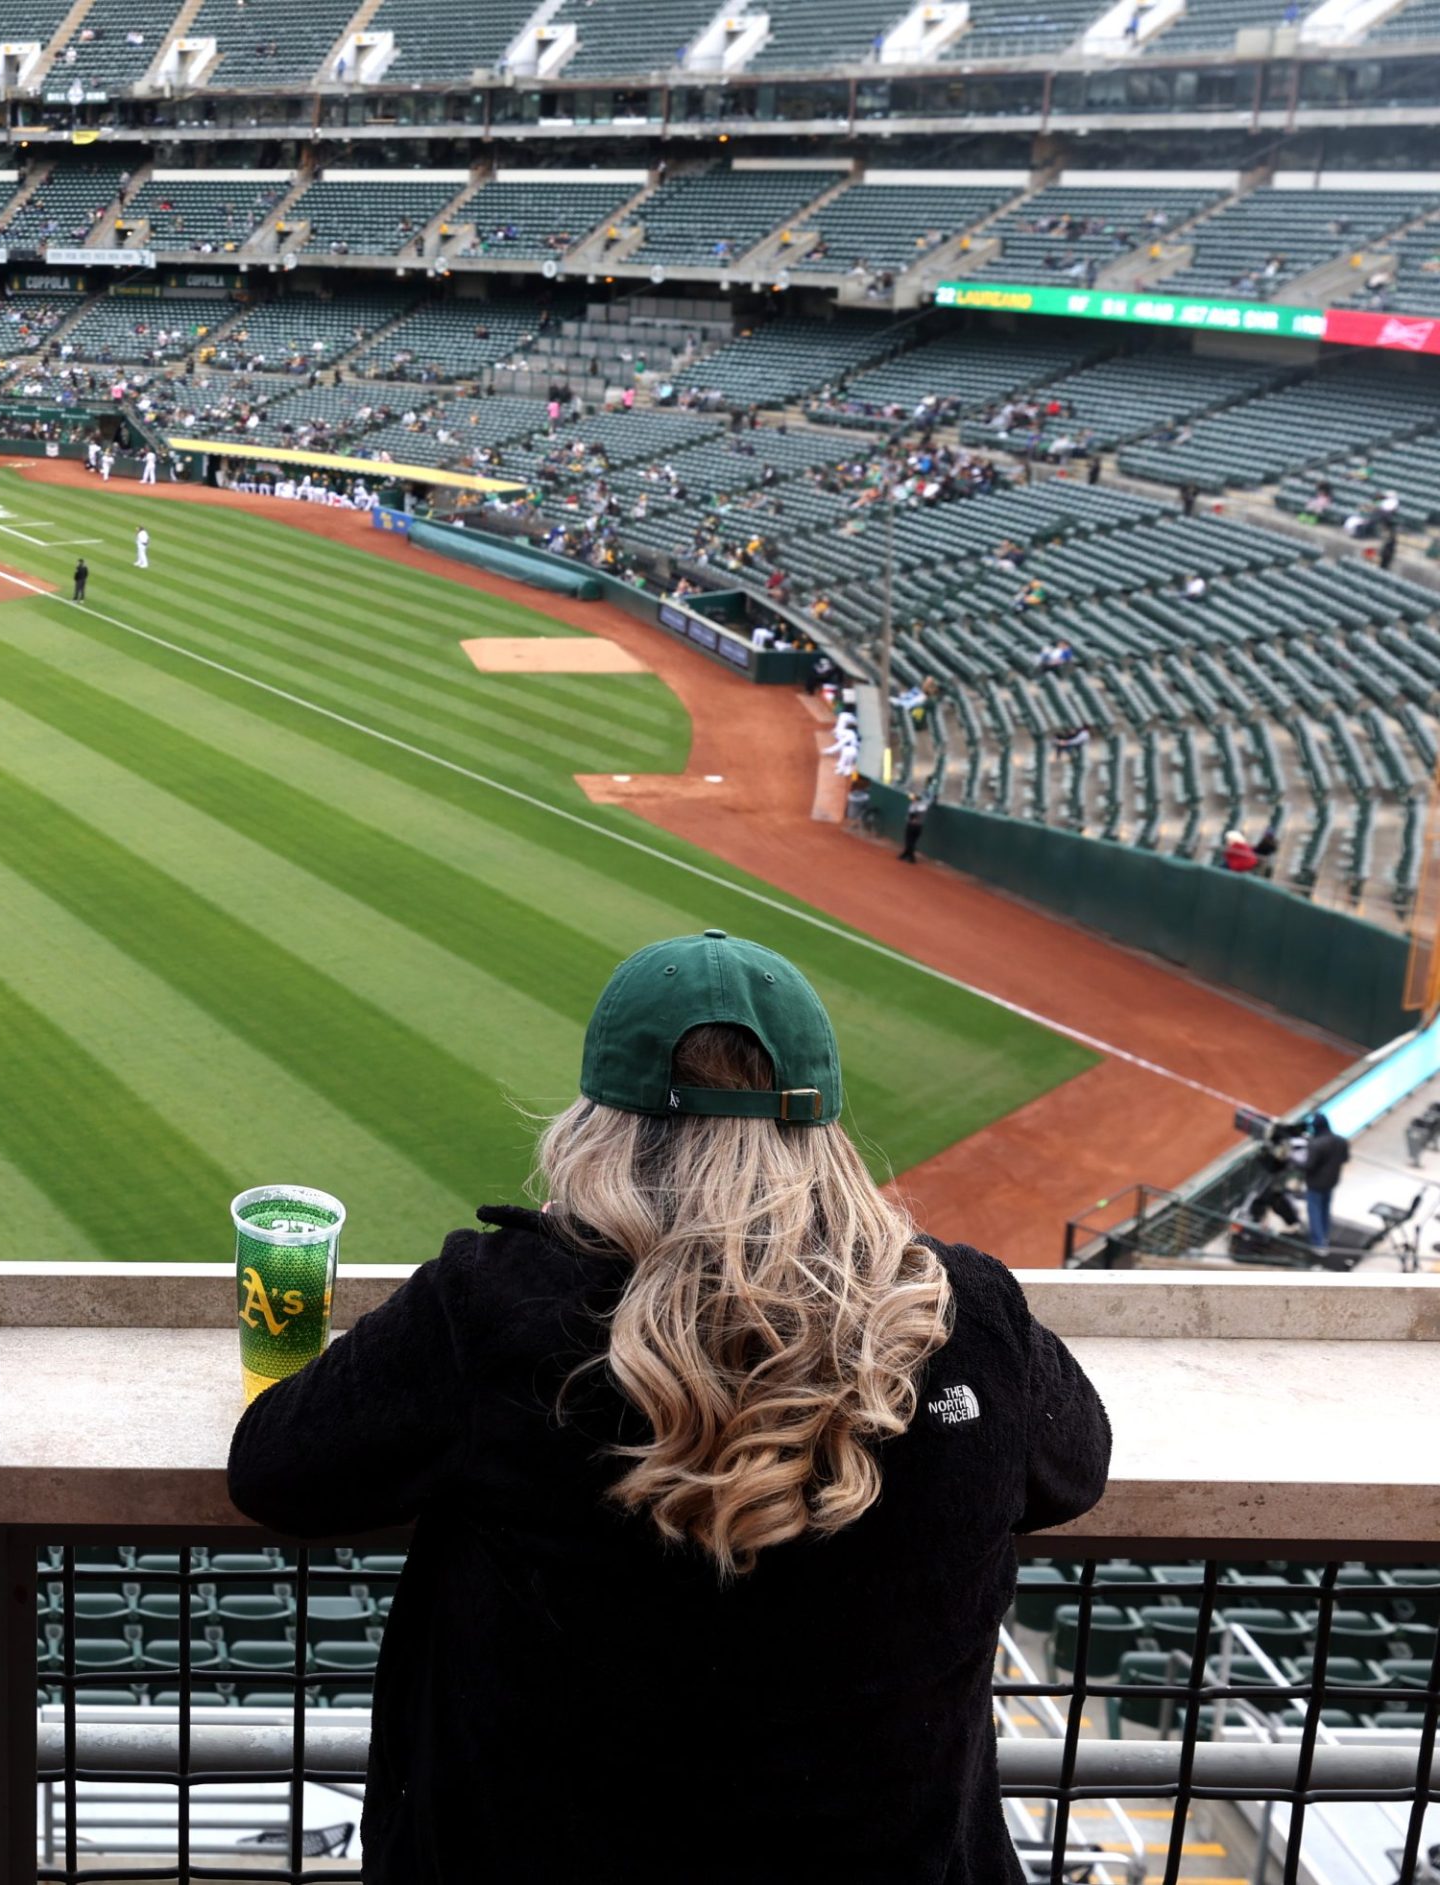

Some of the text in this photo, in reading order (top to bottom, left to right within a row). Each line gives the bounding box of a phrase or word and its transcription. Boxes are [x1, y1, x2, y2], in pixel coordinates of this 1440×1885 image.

[26, 275, 70, 290] COPPOLA
[186, 274, 225, 287] COPPOLA
[957, 290, 1033, 310] LAUREANO
[239, 1266, 306, 1336] A's
[943, 1385, 963, 1400] THE
[927, 1396, 969, 1414] NORTH
[941, 1408, 969, 1425] FACE
